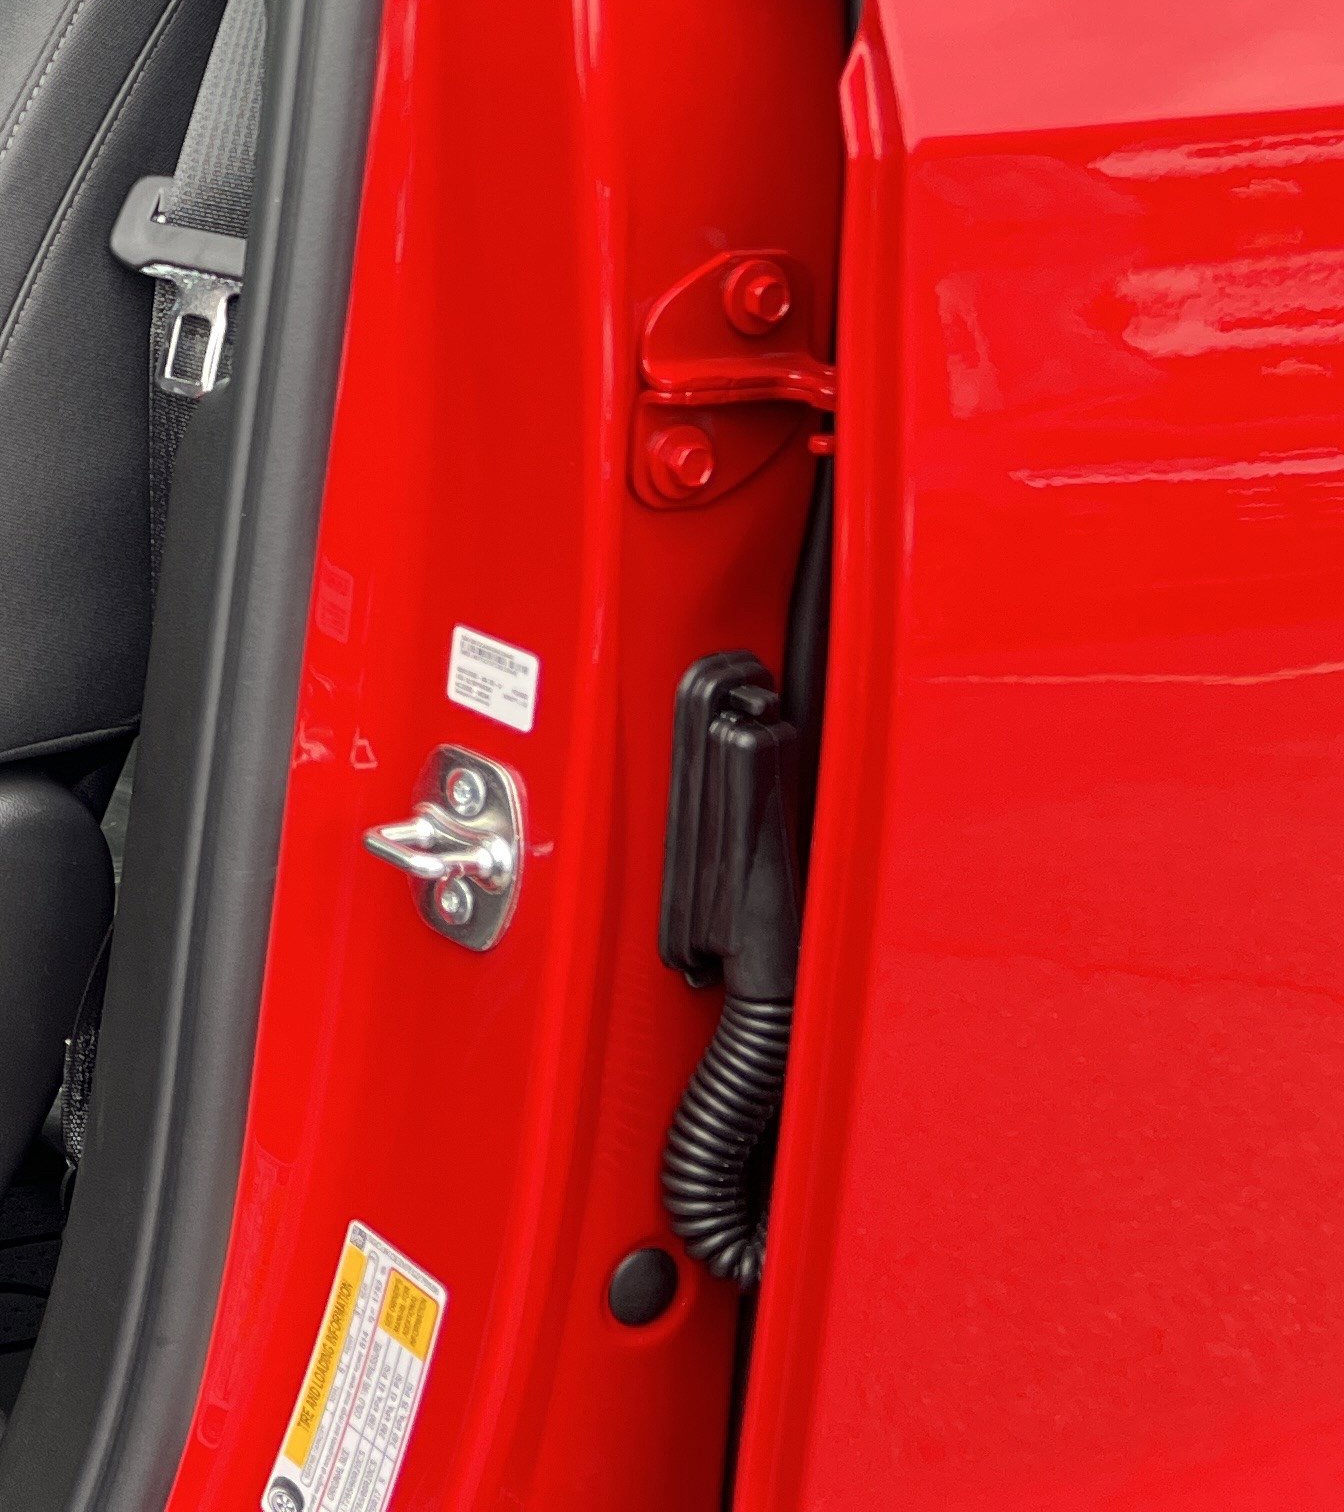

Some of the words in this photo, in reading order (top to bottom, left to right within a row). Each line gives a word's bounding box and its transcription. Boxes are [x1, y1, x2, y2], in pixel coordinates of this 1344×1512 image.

[325, 1278, 353, 1347] INFORMATION
[312, 1343, 335, 1390] LOADING
[305, 1386, 321, 1410] AND
[297, 1405, 315, 1432] TIRE
